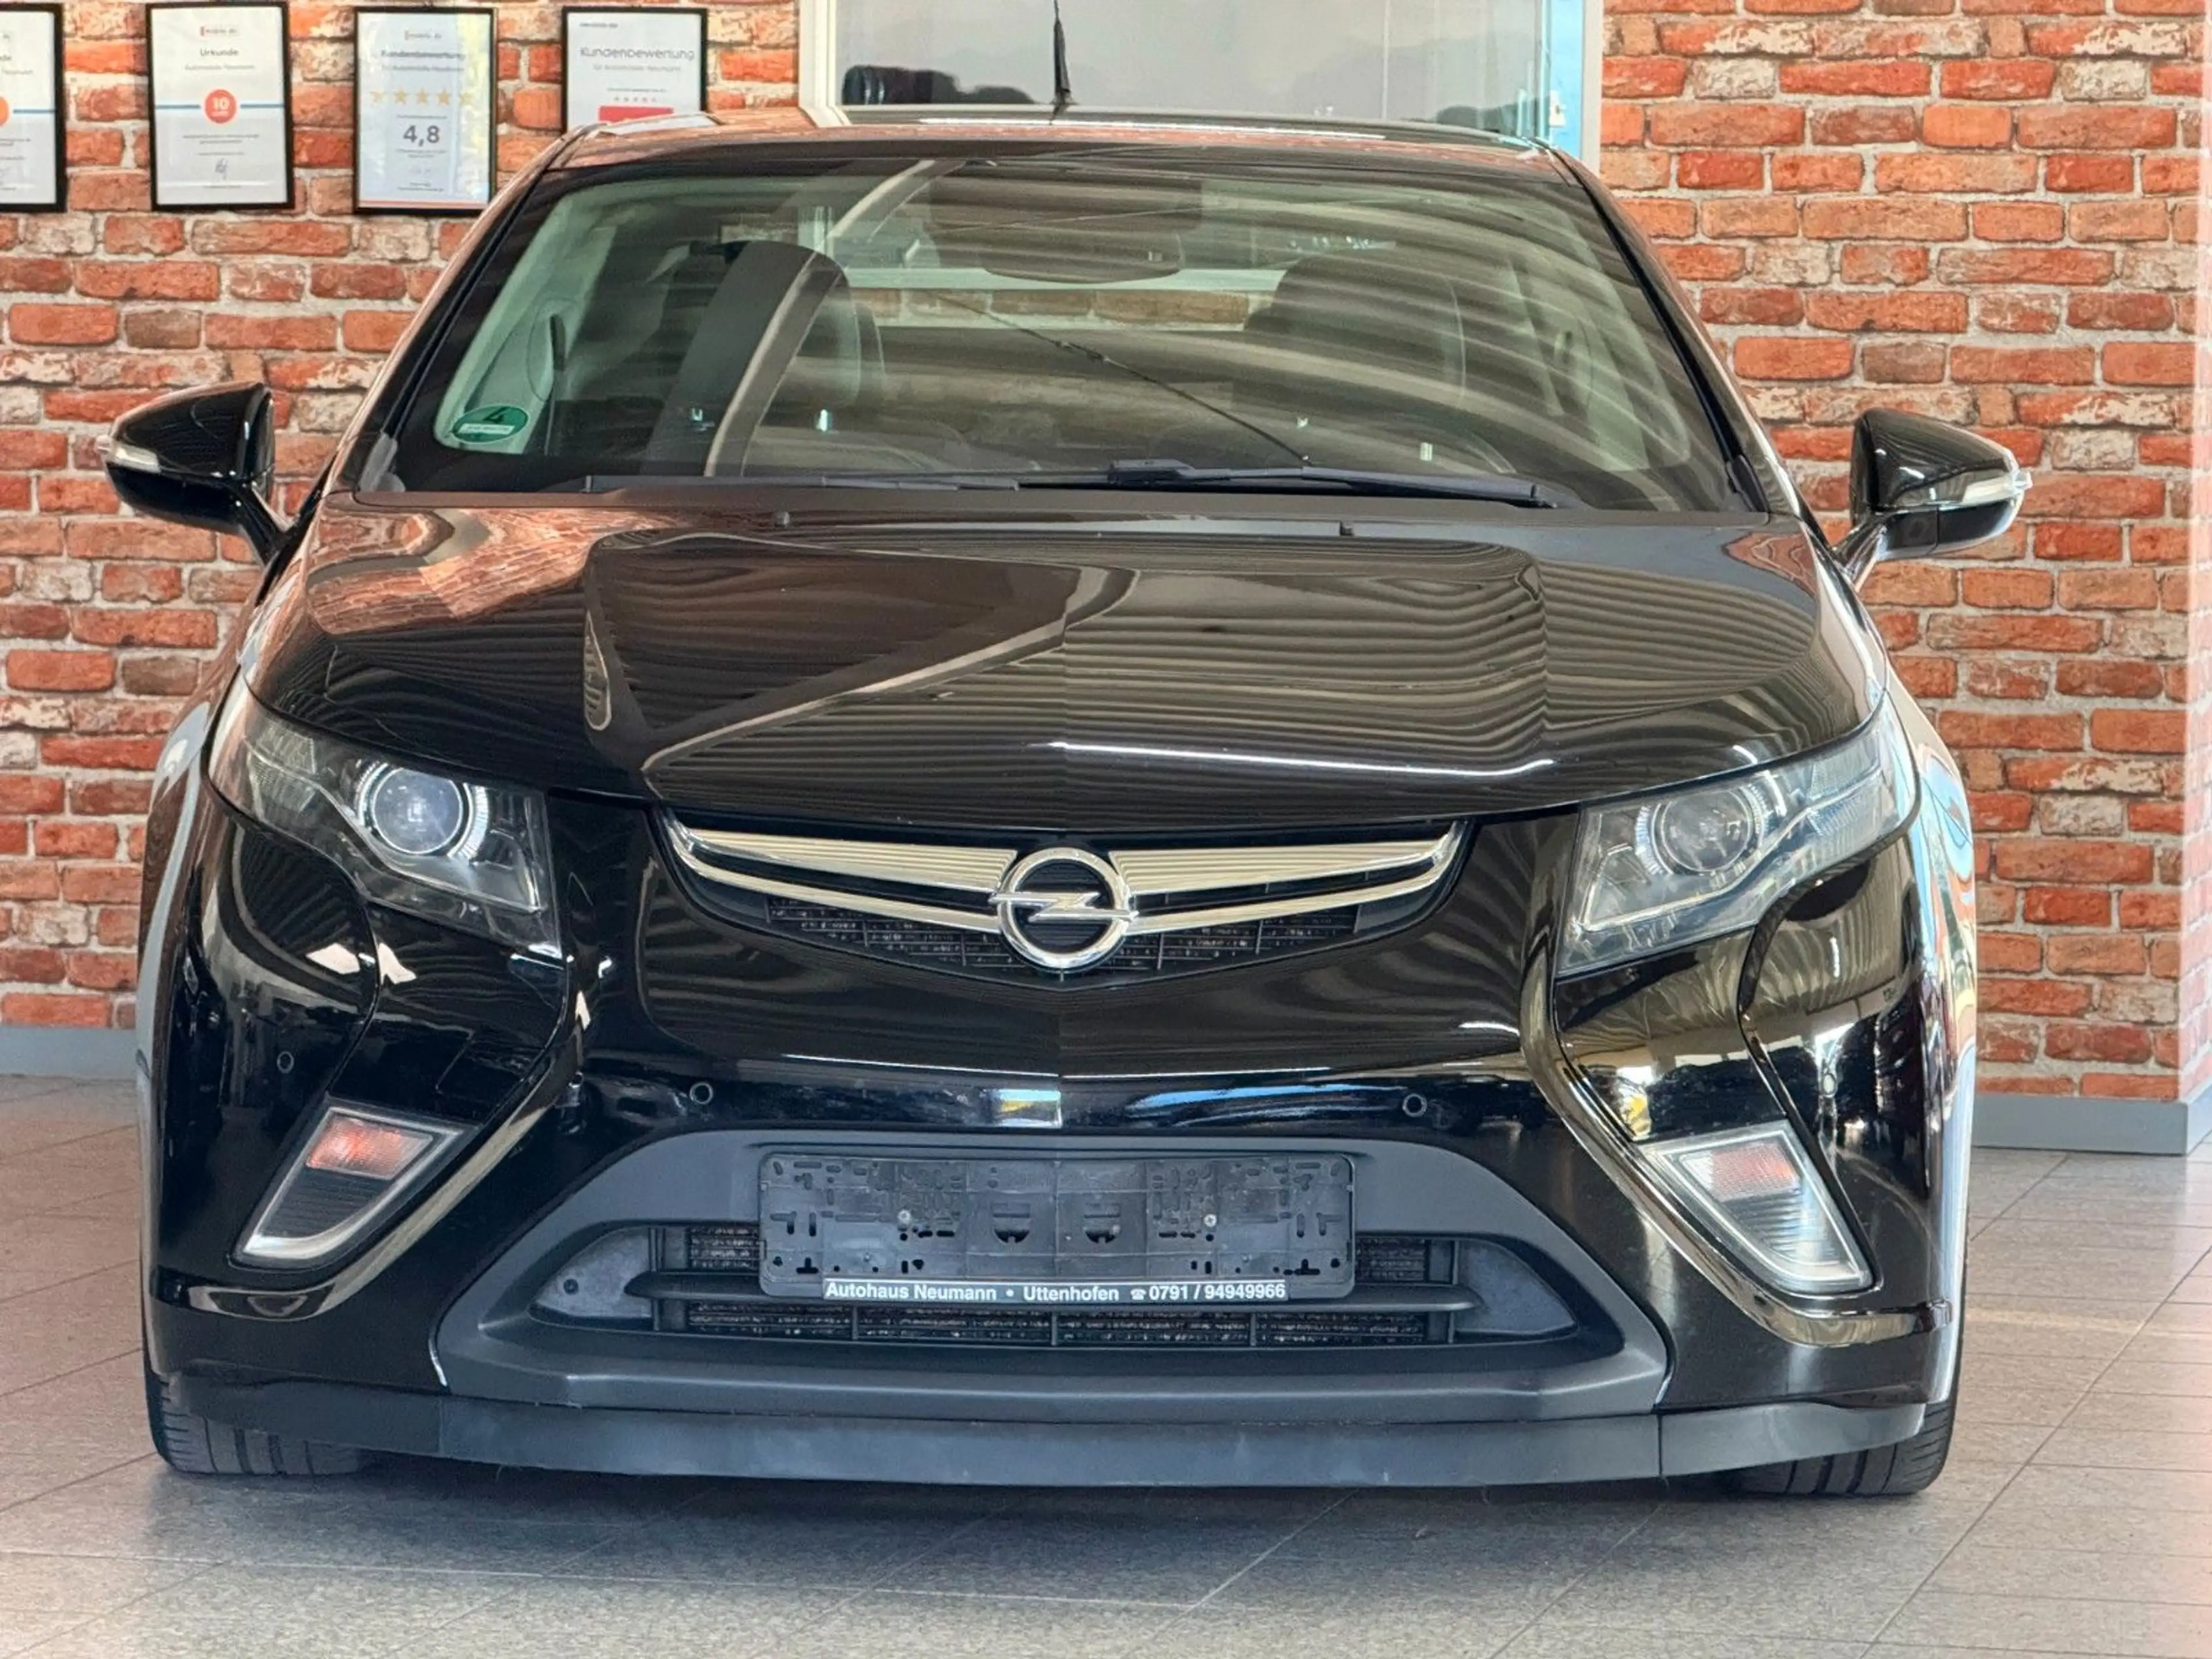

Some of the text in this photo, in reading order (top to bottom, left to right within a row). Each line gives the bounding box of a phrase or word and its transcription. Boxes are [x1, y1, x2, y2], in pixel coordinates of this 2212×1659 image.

[580, 47, 695, 61] Kundenbewertung
[212, 96, 230, 111] 10
[403, 125, 440, 147] 4,8
[825, 1282, 1286, 1302] Autohaus Neumann Uttenhofen 0791 / 94949966
